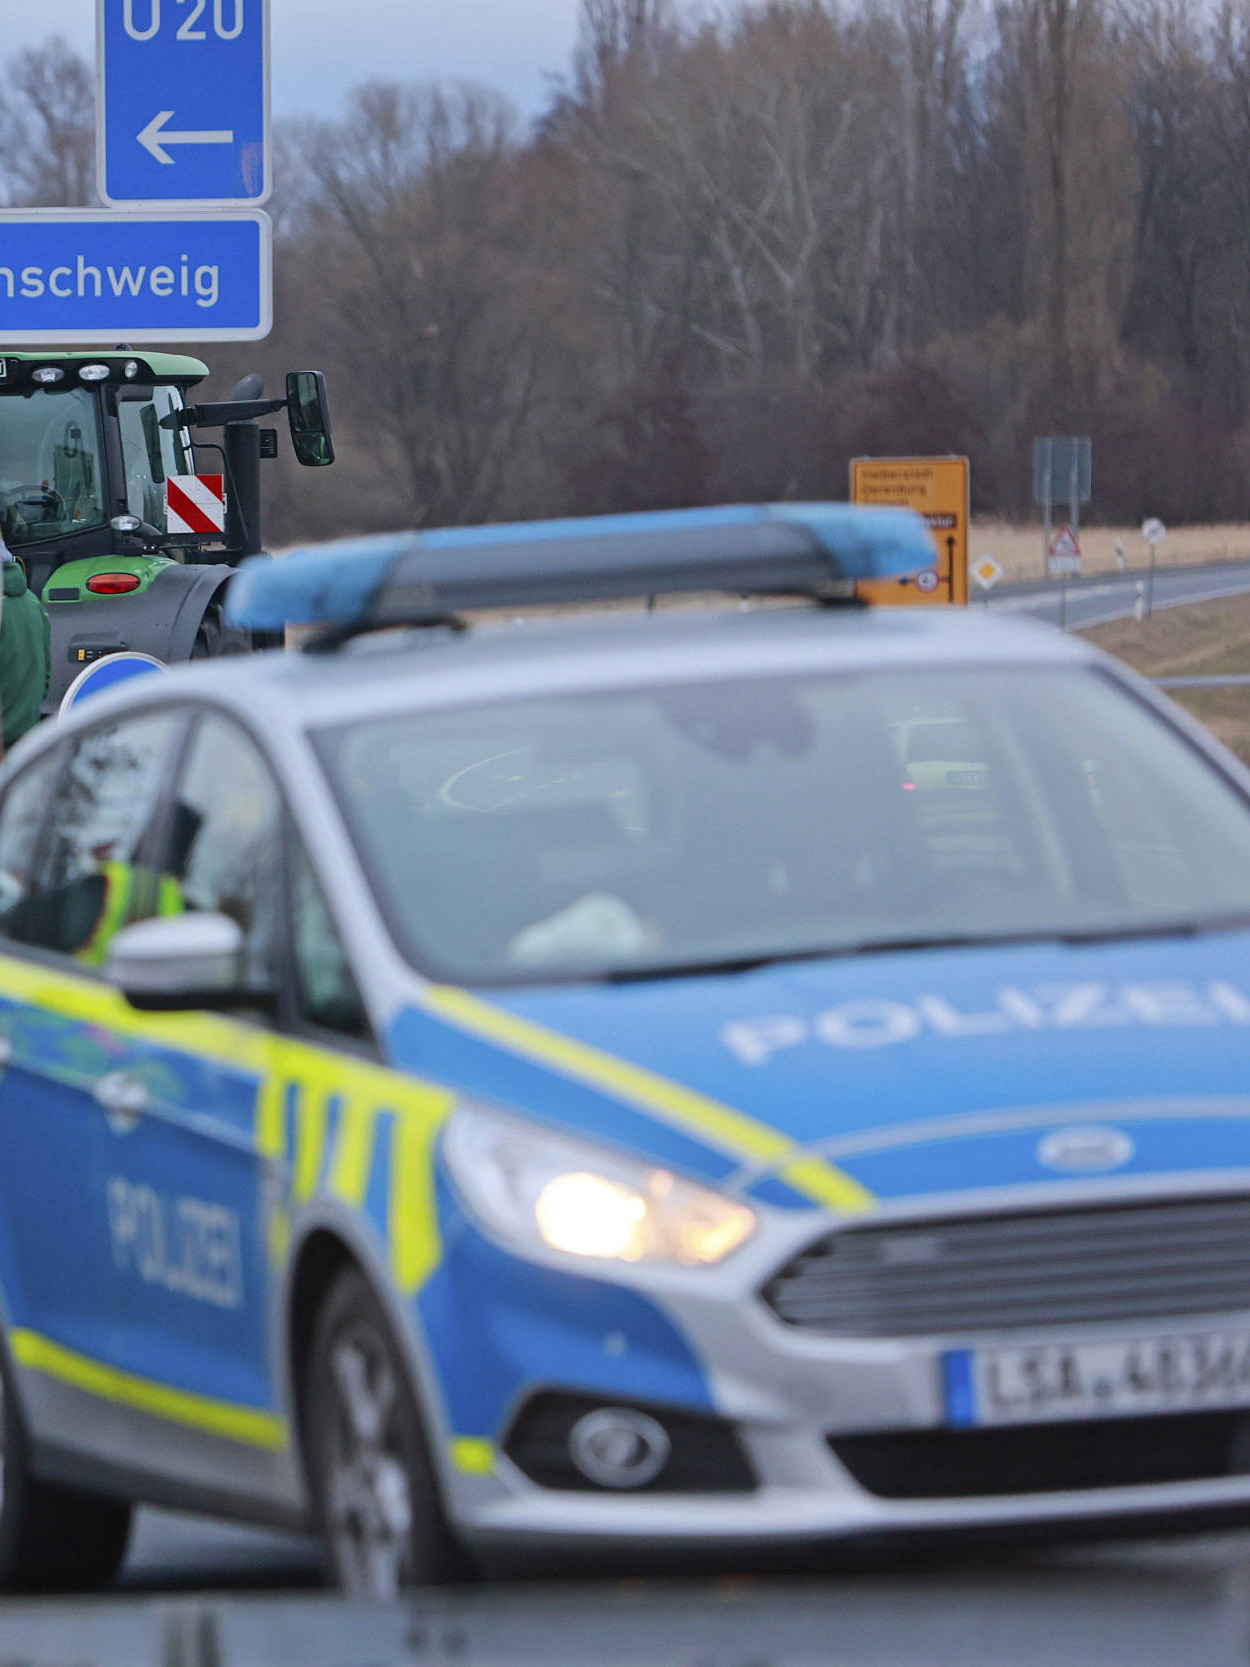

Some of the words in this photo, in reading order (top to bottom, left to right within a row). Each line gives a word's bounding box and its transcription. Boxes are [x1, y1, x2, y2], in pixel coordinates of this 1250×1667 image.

[123, 0, 161, 41] U
[176, 0, 244, 40] 20
[720, 980, 1250, 1067] POLIZEI
[106, 1174, 246, 1310] POLIZEI
